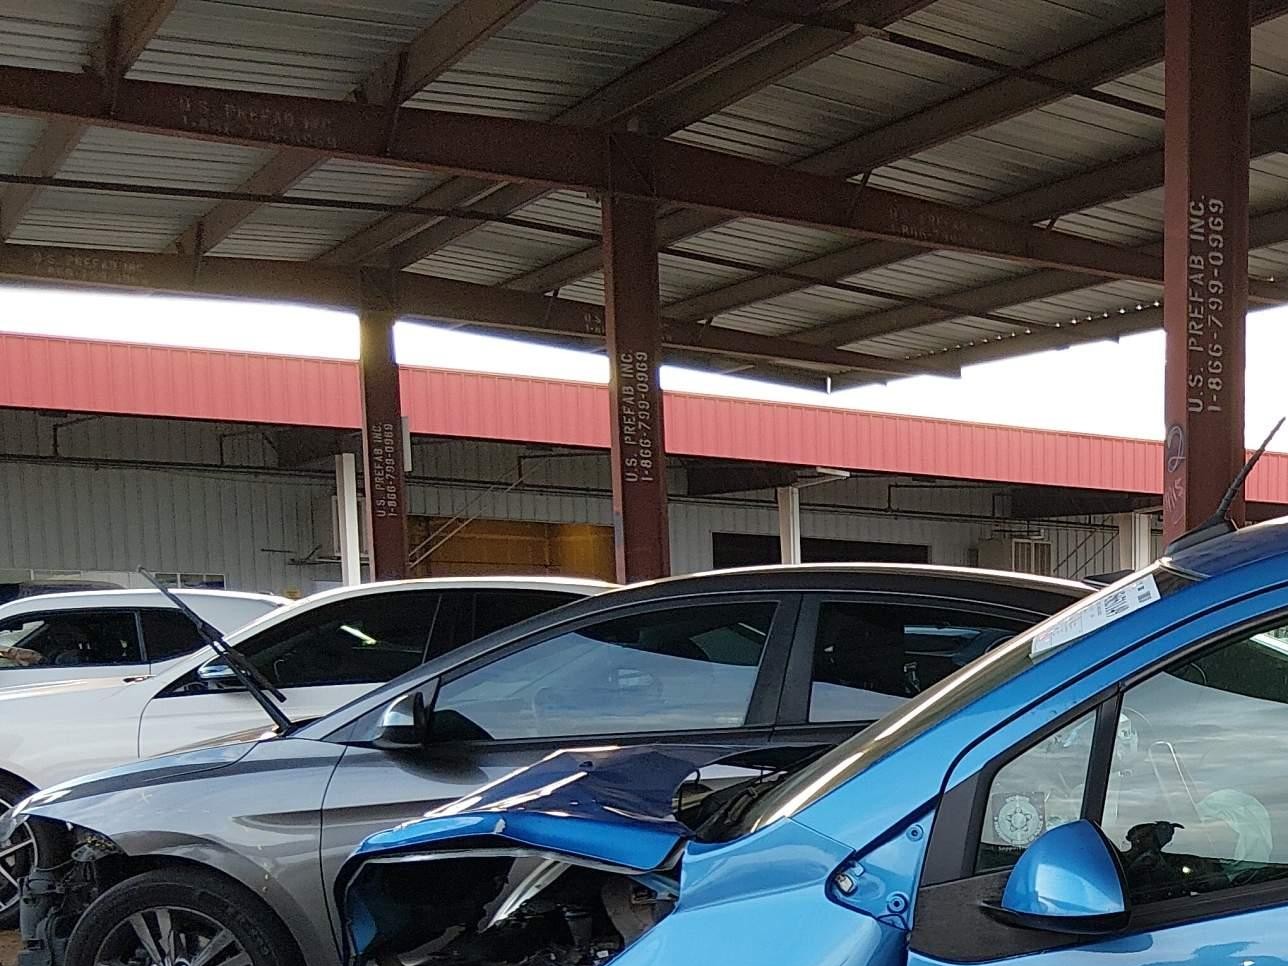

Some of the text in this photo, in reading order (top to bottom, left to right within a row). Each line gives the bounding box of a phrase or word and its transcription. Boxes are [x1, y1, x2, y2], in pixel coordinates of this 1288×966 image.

[1188, 194, 1205, 413] U.S. PREFAB INC.
[1208, 198, 1224, 413] 1-866-799-0969
[622, 386, 637, 445] PREFAB
[635, 351, 654, 481] 1-866-799-0969
[373, 448, 385, 491] PREFAB
[625, 454, 638, 482] U.S.
